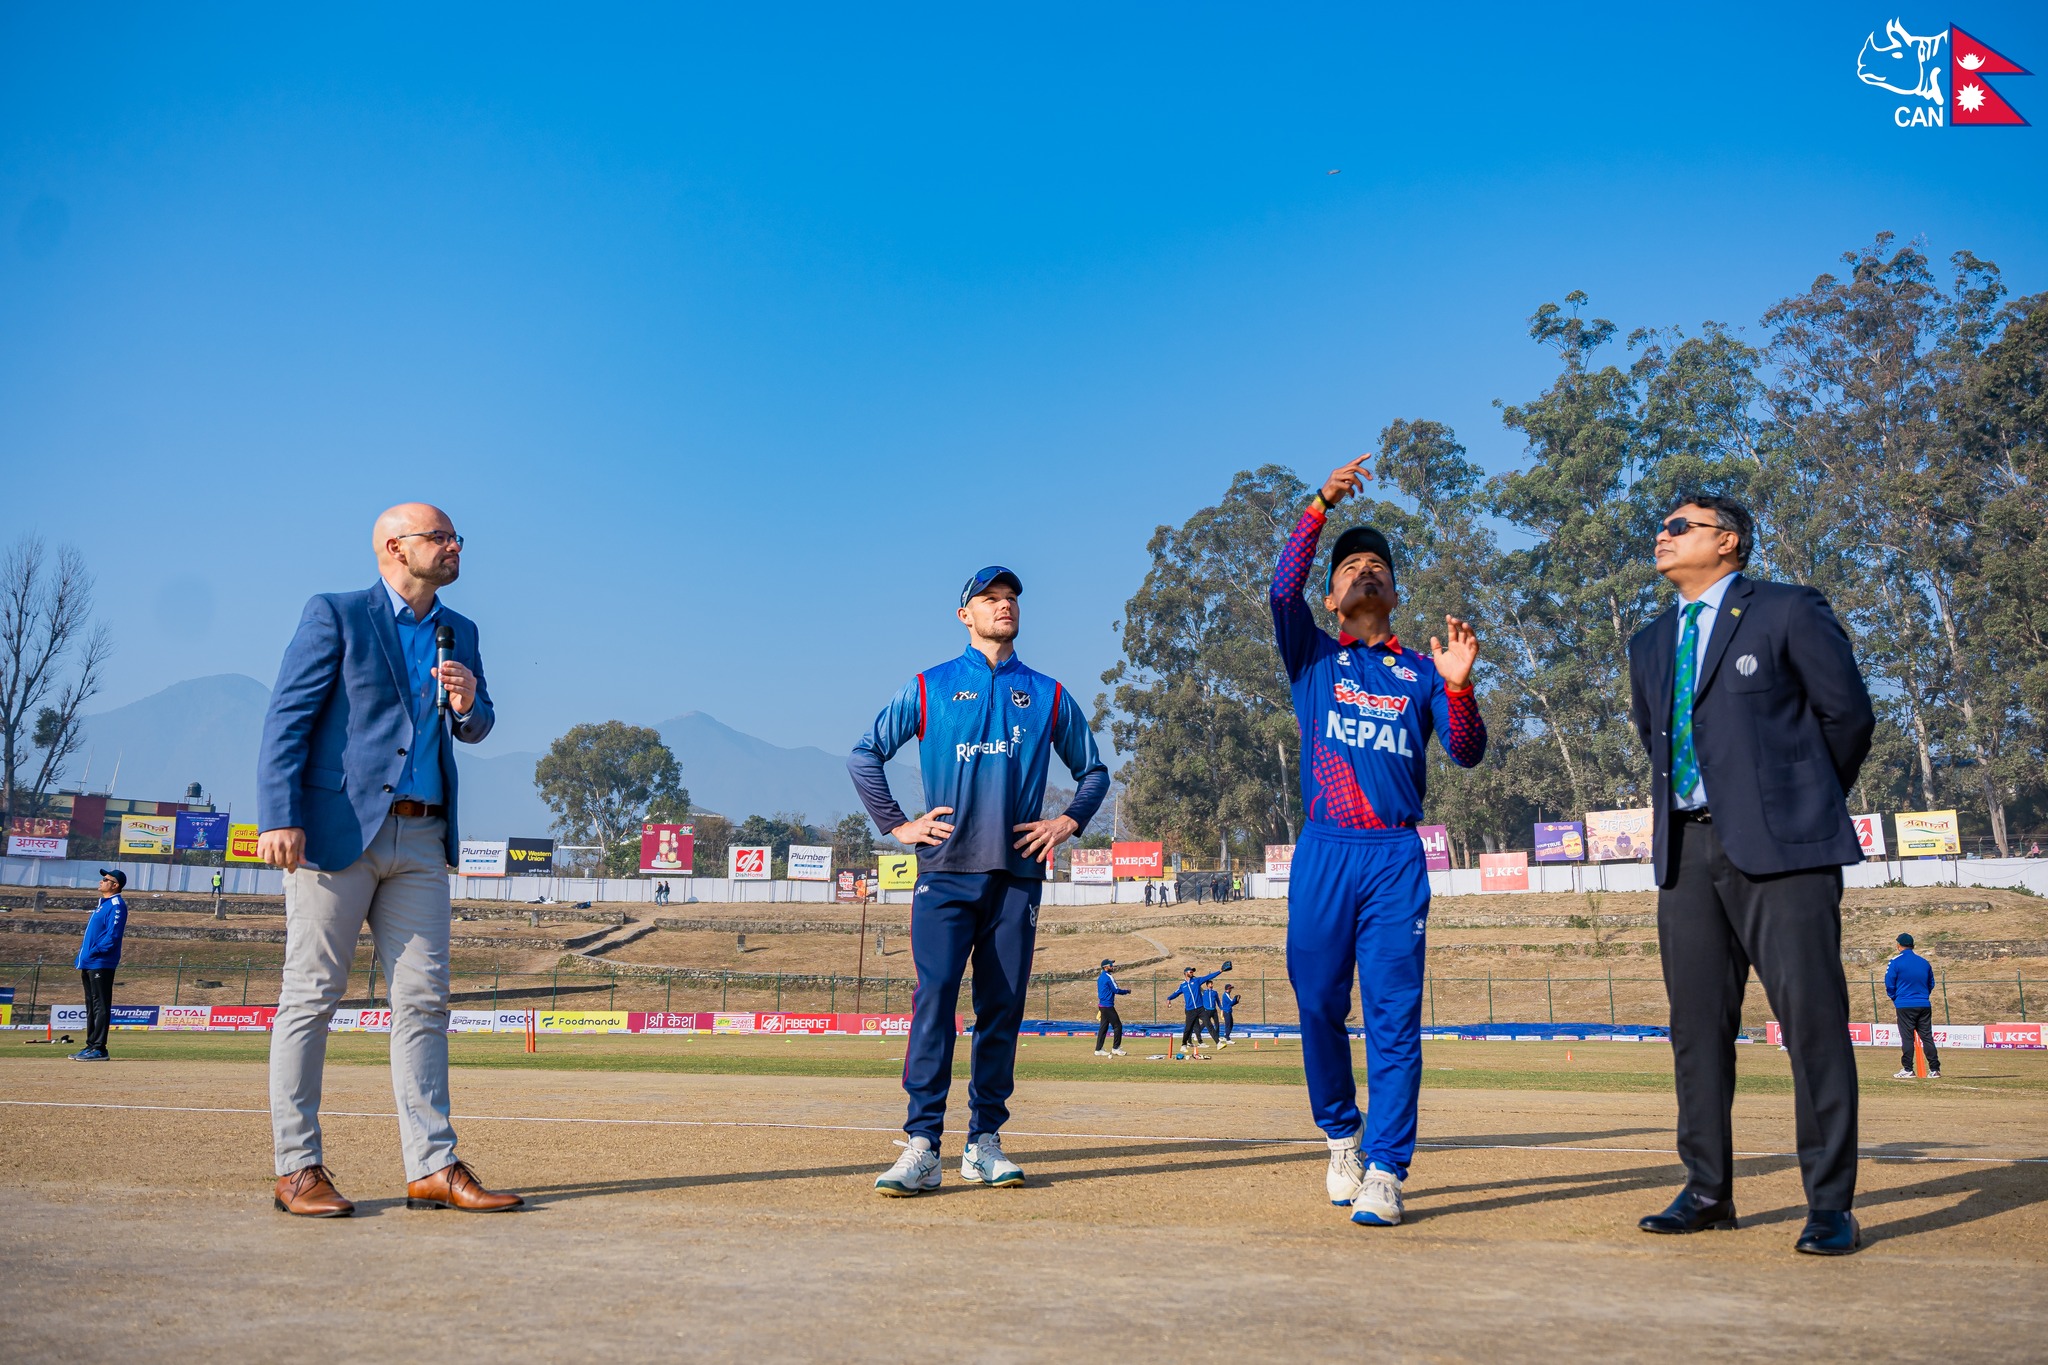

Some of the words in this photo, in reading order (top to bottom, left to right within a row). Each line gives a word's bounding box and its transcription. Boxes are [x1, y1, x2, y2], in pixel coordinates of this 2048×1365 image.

[1334, 684, 1408, 713] Second
[1326, 710, 1413, 758] NEPAL
[462, 847, 501, 855] Plumber
[791, 853, 828, 861] Plumber
[1496, 866, 1524, 876] KFC
[57, 1010, 87, 1019] aec
[110, 1008, 154, 1016] Plumber
[559, 1018, 620, 1026] Foodmandu
[649, 1013, 664, 1027] श्री
[785, 1019, 831, 1028] FIBERNET
[2005, 1032, 2039, 1041] KFC
